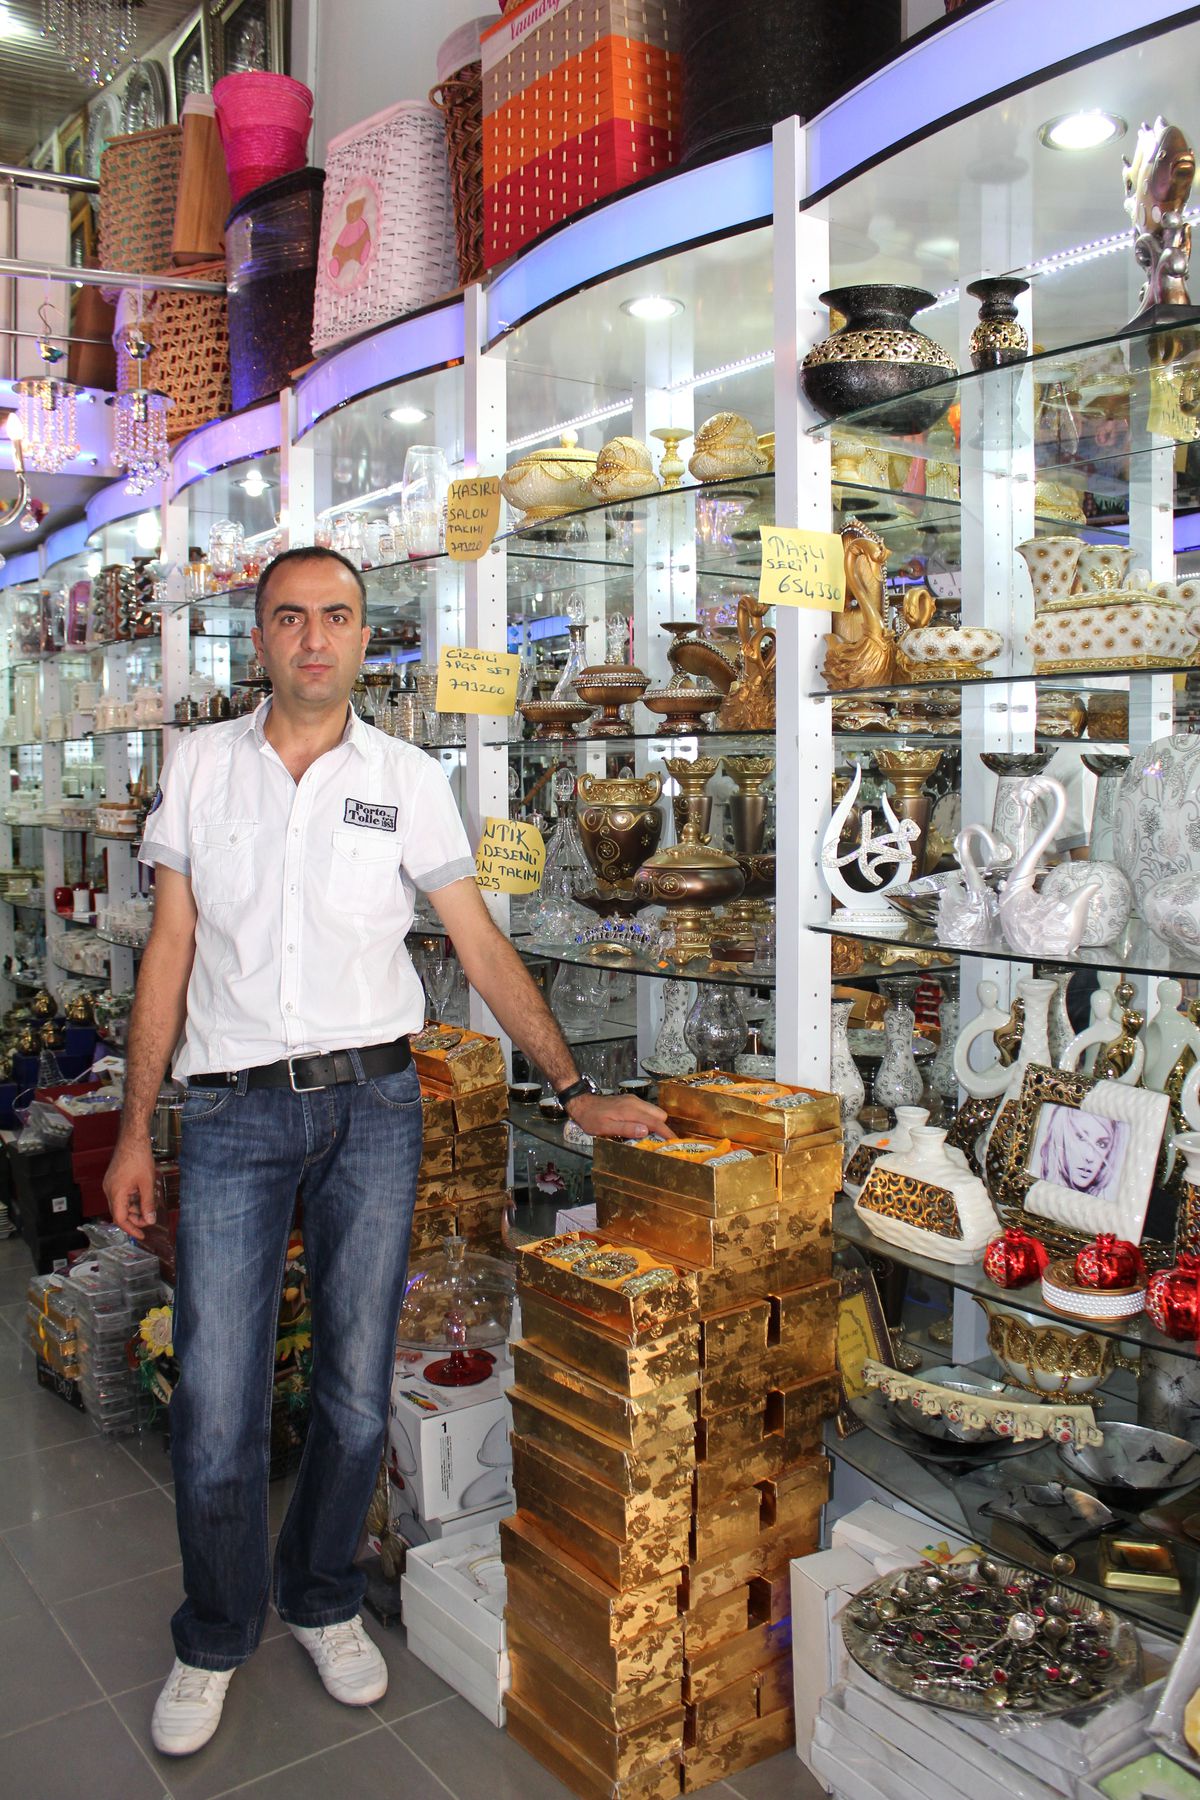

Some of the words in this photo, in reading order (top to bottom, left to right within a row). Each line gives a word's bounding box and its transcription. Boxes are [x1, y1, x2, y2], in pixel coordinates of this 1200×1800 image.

[448, 508, 489, 521] SALON
[778, 574, 841, 600] 654330
[486, 667, 510, 676] SET
[449, 678, 505, 695] 793200
[355, 803, 386, 816] Porto
[348, 810, 380, 825] Tolle
[441, 1421, 447, 1434] 1
